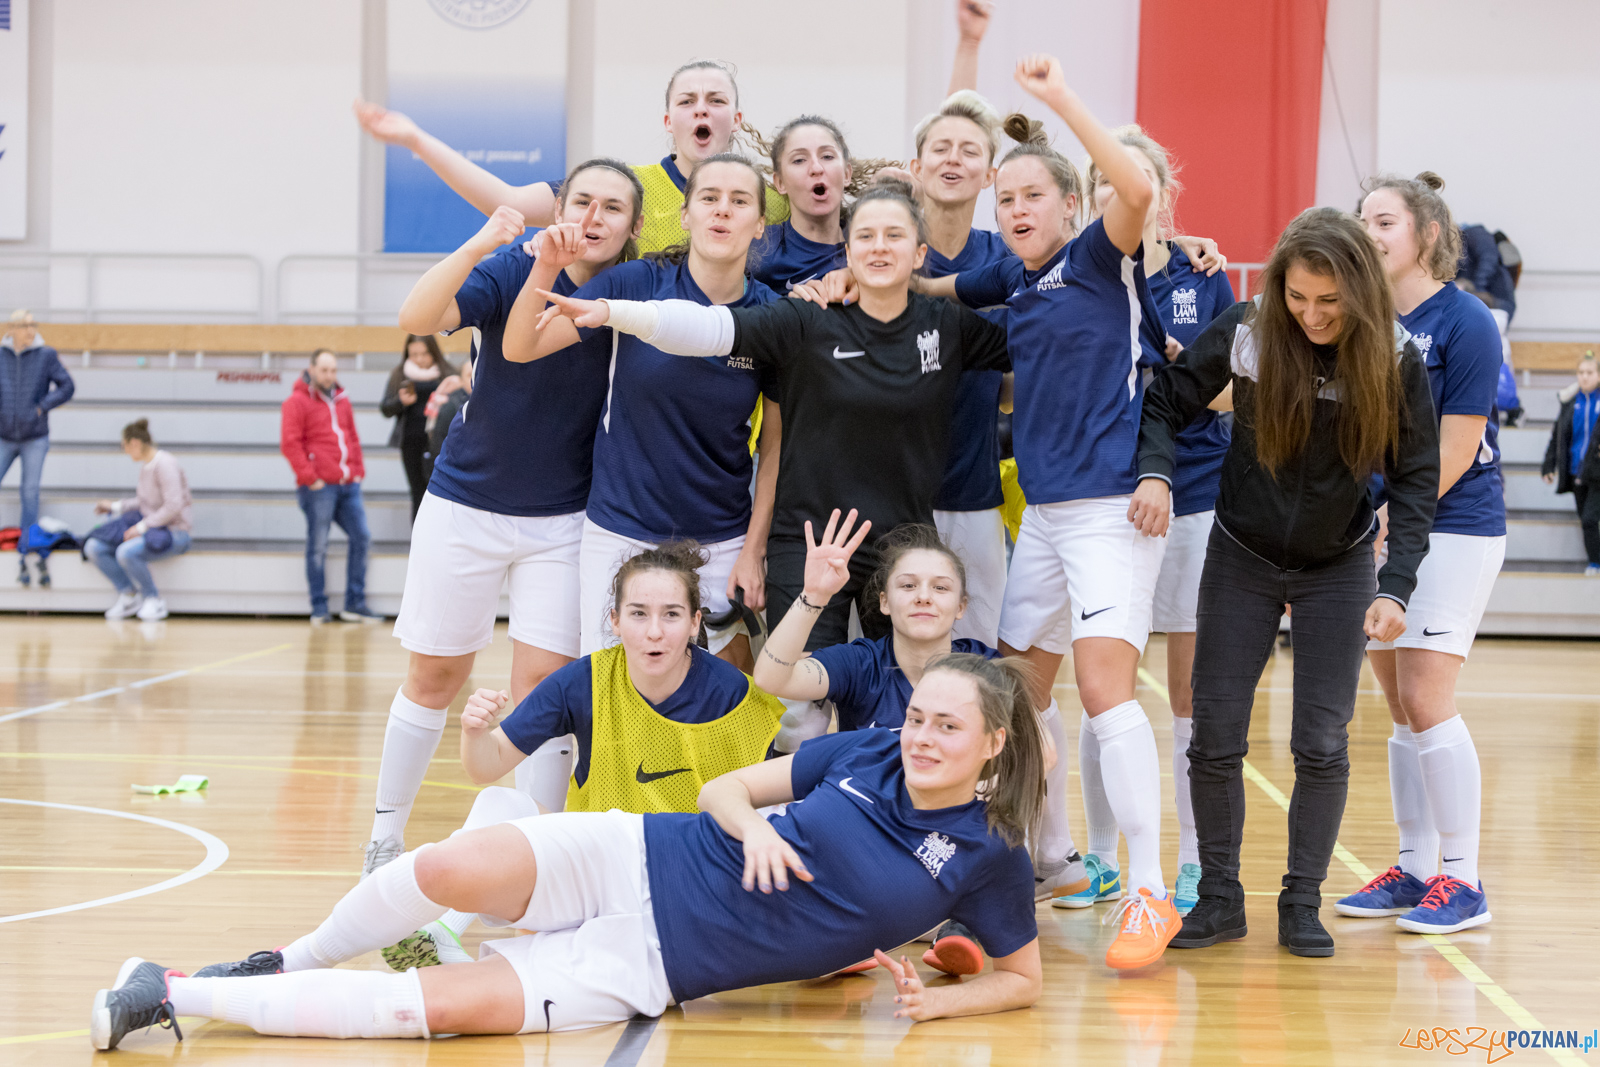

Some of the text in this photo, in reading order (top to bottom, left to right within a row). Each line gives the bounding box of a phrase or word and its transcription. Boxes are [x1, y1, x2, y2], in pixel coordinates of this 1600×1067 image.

[1037, 281, 1067, 292] FUTSAL
[1173, 304, 1197, 318] UAM
[1173, 317, 1199, 325] FUTSAL
[726, 359, 755, 370] FUTSAL
[916, 844, 945, 875] UAM
